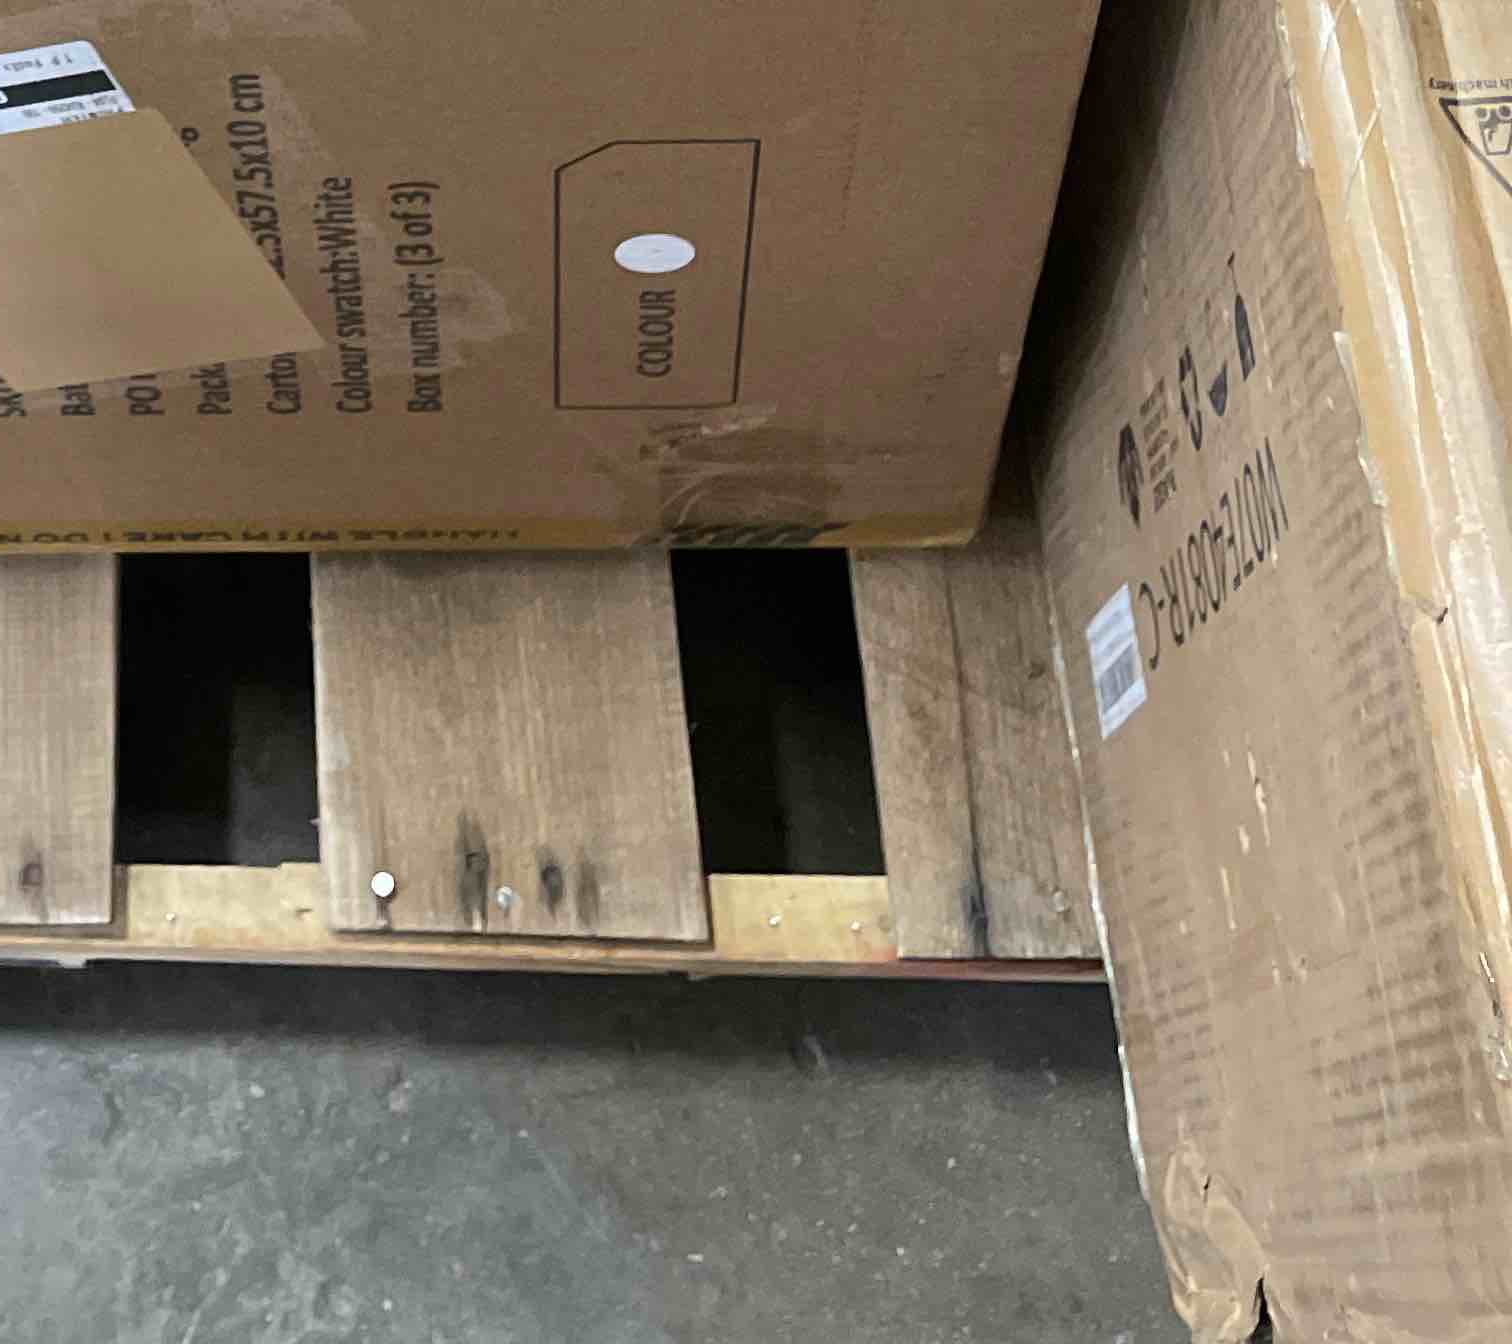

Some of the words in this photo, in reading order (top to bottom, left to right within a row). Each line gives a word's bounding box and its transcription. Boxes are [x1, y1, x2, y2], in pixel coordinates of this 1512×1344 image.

[230, 74, 265, 113] cm
[392, 209, 435, 236] of
[398, 271, 443, 369] number:
[636, 288, 677, 379] COLOUR
[330, 337, 373, 414] Colour
[406, 371, 443, 413] Box
